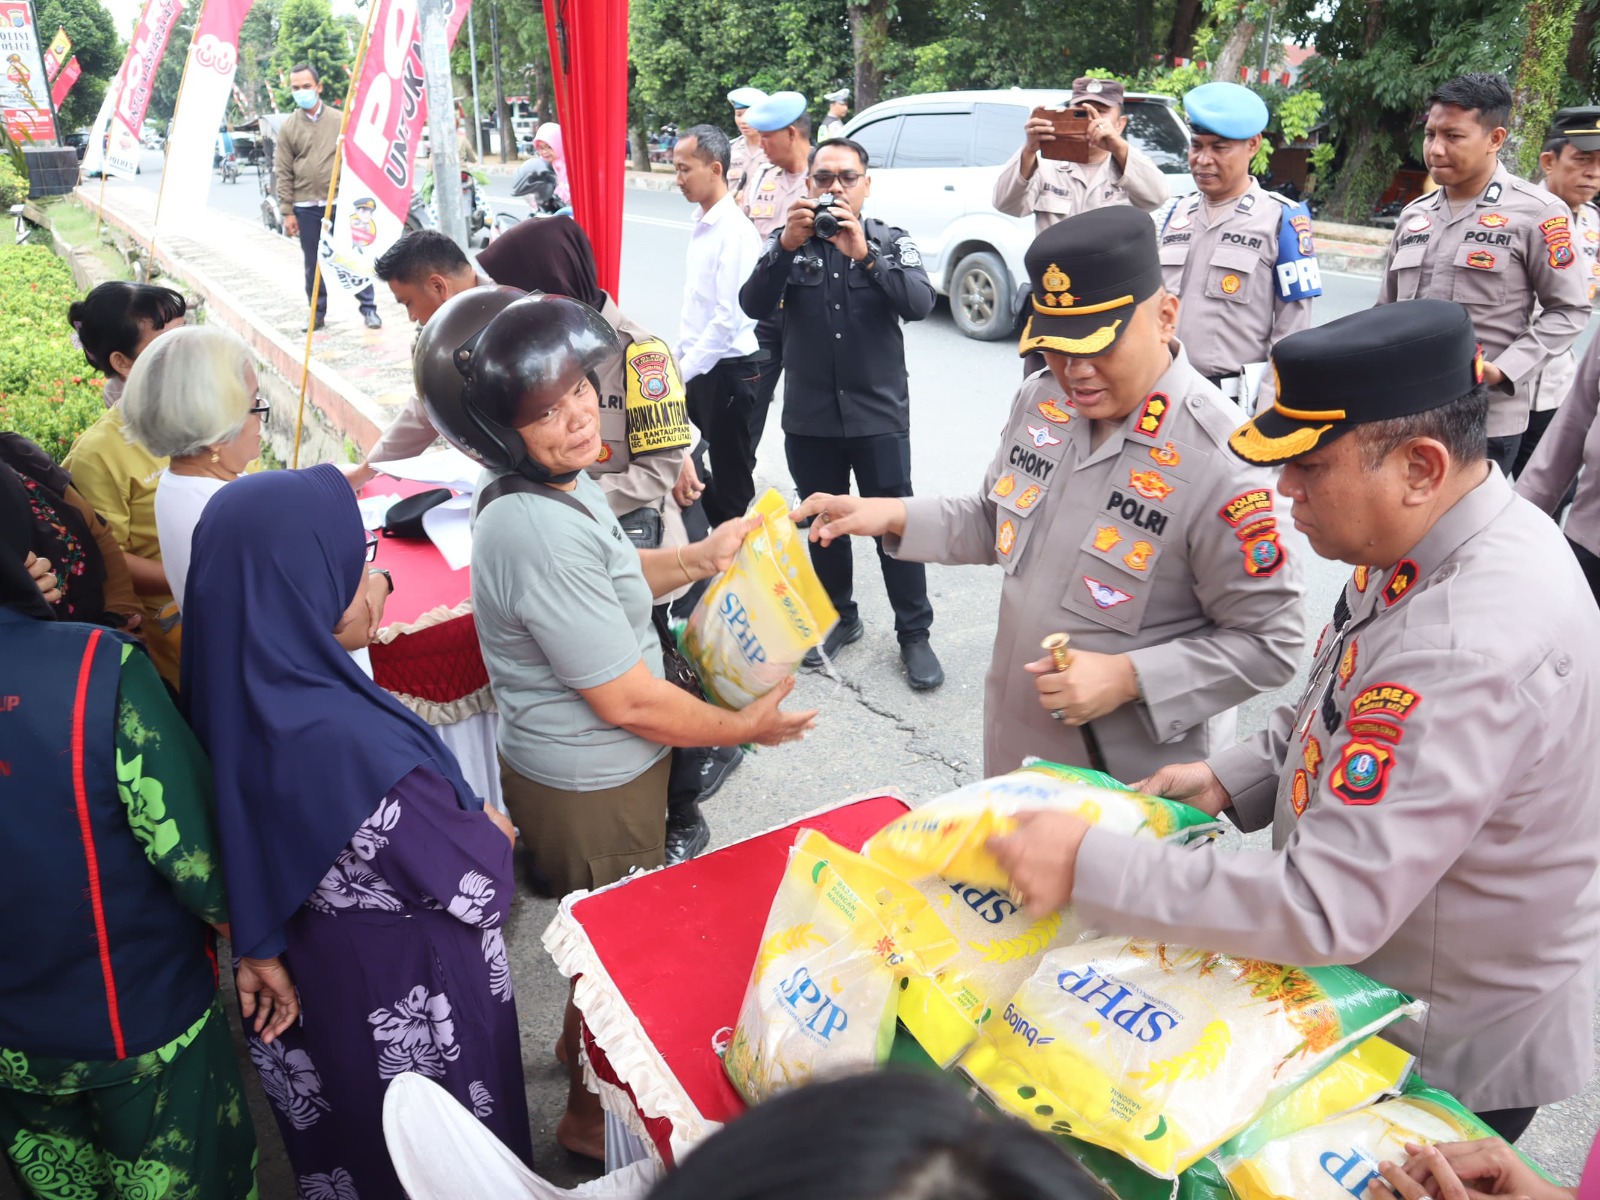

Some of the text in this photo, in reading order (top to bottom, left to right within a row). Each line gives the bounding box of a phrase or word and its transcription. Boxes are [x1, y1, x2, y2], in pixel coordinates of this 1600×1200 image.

[0, 32, 29, 42] OLISI
[0, 42, 31, 52] OLICE
[1221, 232, 1262, 249] POLRI
[1464, 231, 1511, 246] POLRI
[600, 394, 623, 410] LRI
[646, 435, 676, 445] RANTAU
[1009, 444, 1053, 481] CHOKY
[1106, 491, 1168, 537] POLRI
[1227, 491, 1268, 514] POLRES
[719, 592, 767, 665] SPHP
[1354, 687, 1414, 709] POLRES
[826, 891, 857, 922] NASIONAL
[831, 886, 857, 912] PANGAN
[1057, 966, 1179, 1043] SPHP
[1003, 1003, 1039, 1047] bulog
[1110, 1087, 1142, 1111] NASIONAL
[1110, 1098, 1137, 1117] PANGAN
